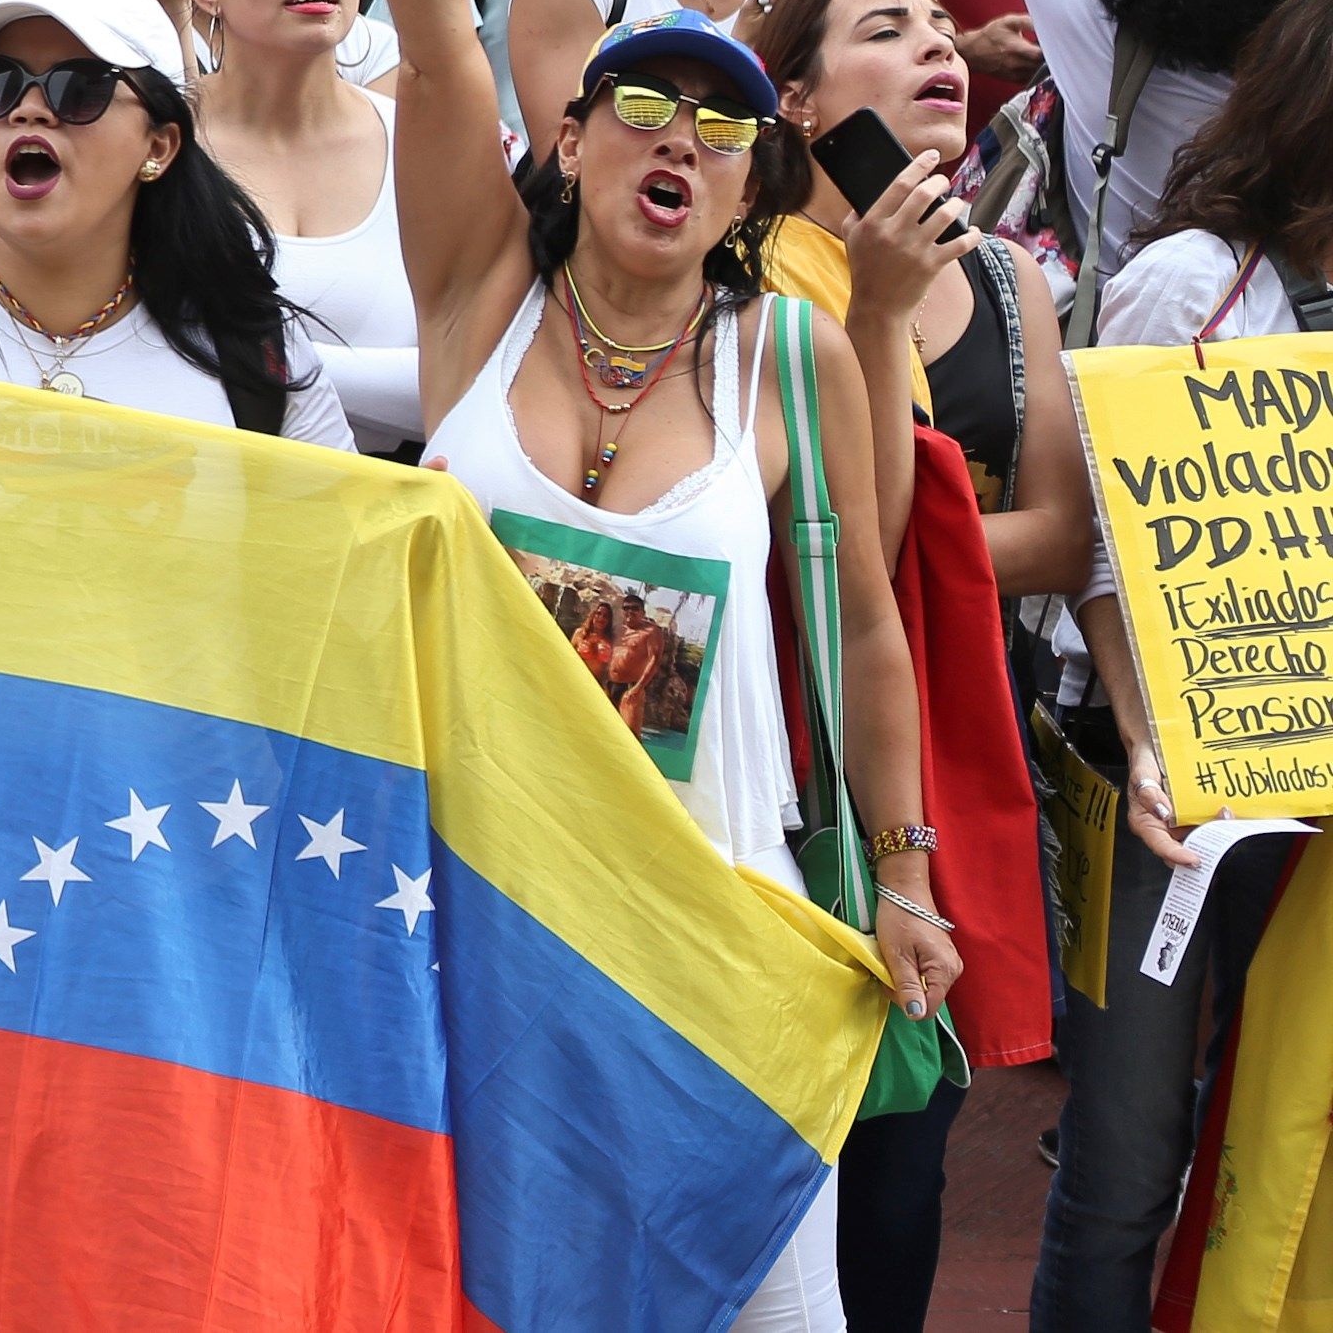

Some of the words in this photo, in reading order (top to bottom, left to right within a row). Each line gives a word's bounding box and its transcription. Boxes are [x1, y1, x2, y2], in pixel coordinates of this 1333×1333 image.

[1112, 432, 1333, 506] Violado
[1171, 635, 1327, 682] Derecho
[1161, 912, 1190, 935] PUEBLO
